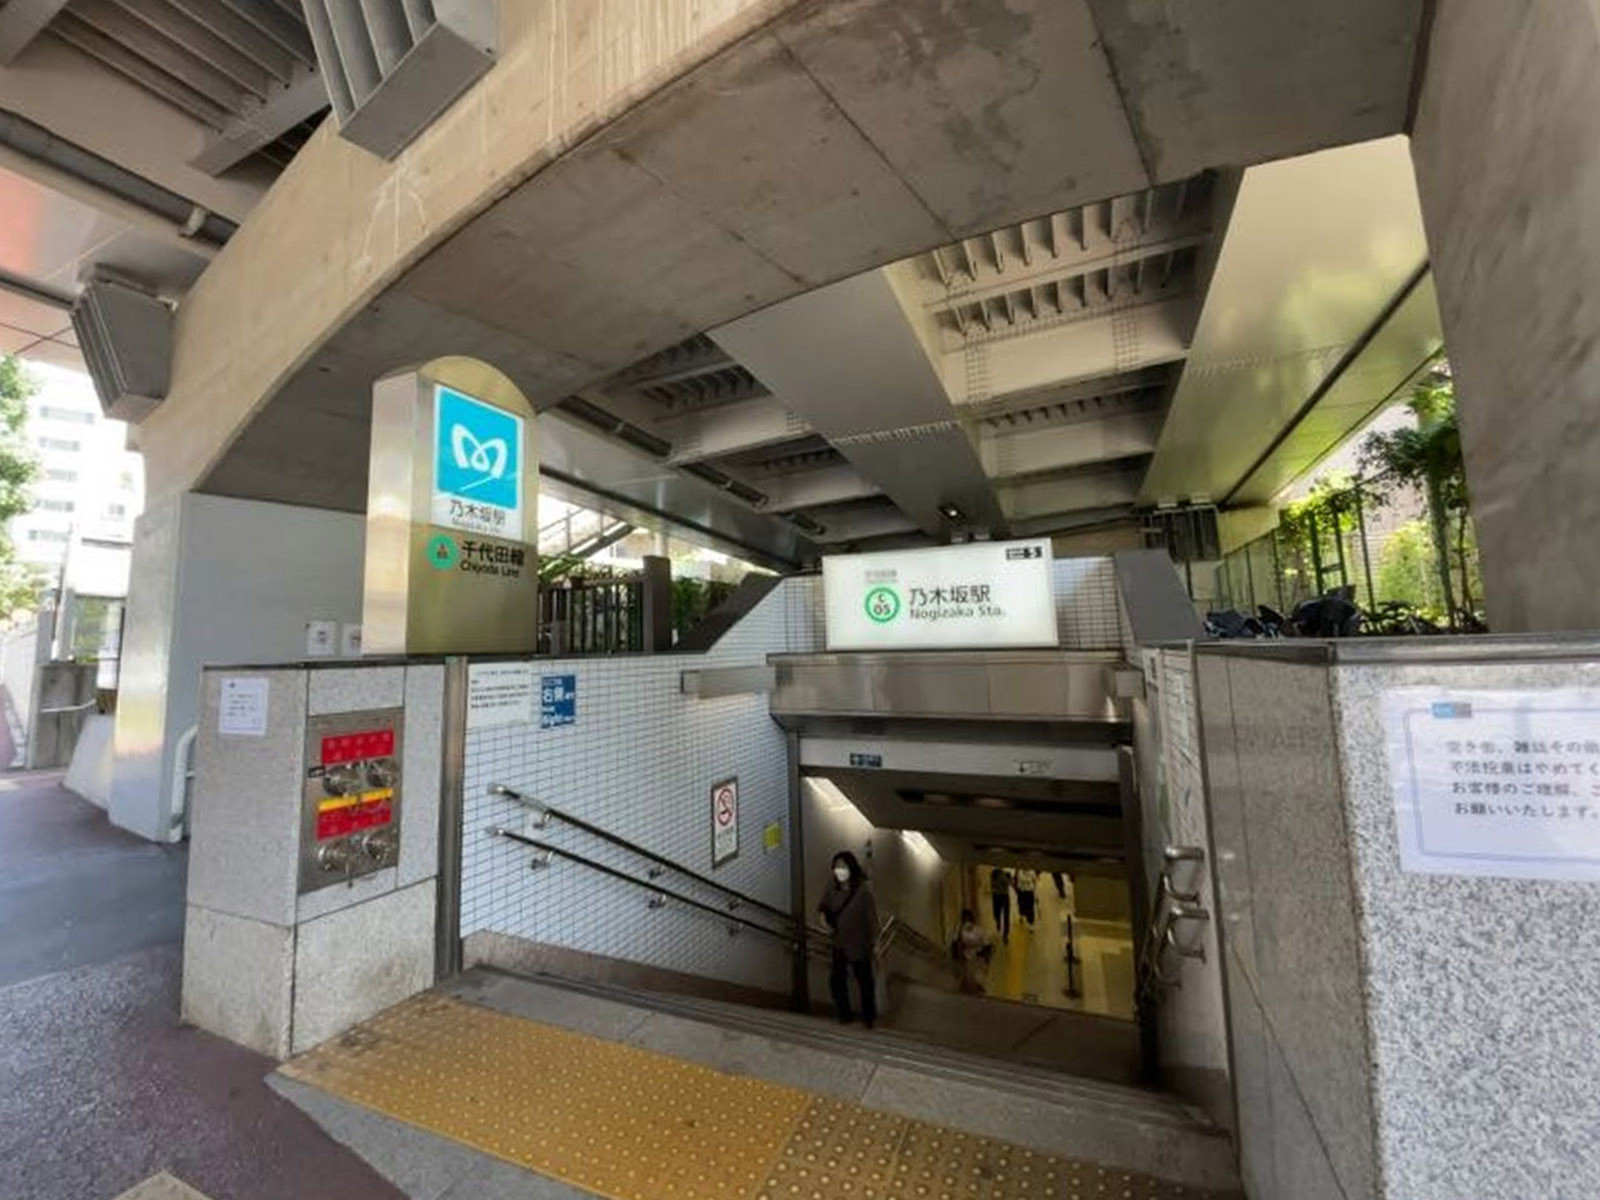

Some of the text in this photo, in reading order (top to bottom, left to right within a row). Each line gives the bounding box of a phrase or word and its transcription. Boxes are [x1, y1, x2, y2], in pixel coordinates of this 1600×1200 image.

[909, 585, 991, 607] 乃木坂駅
[872, 603, 891, 616] 05
[909, 605, 1006, 622] Nogizaka Sta.
